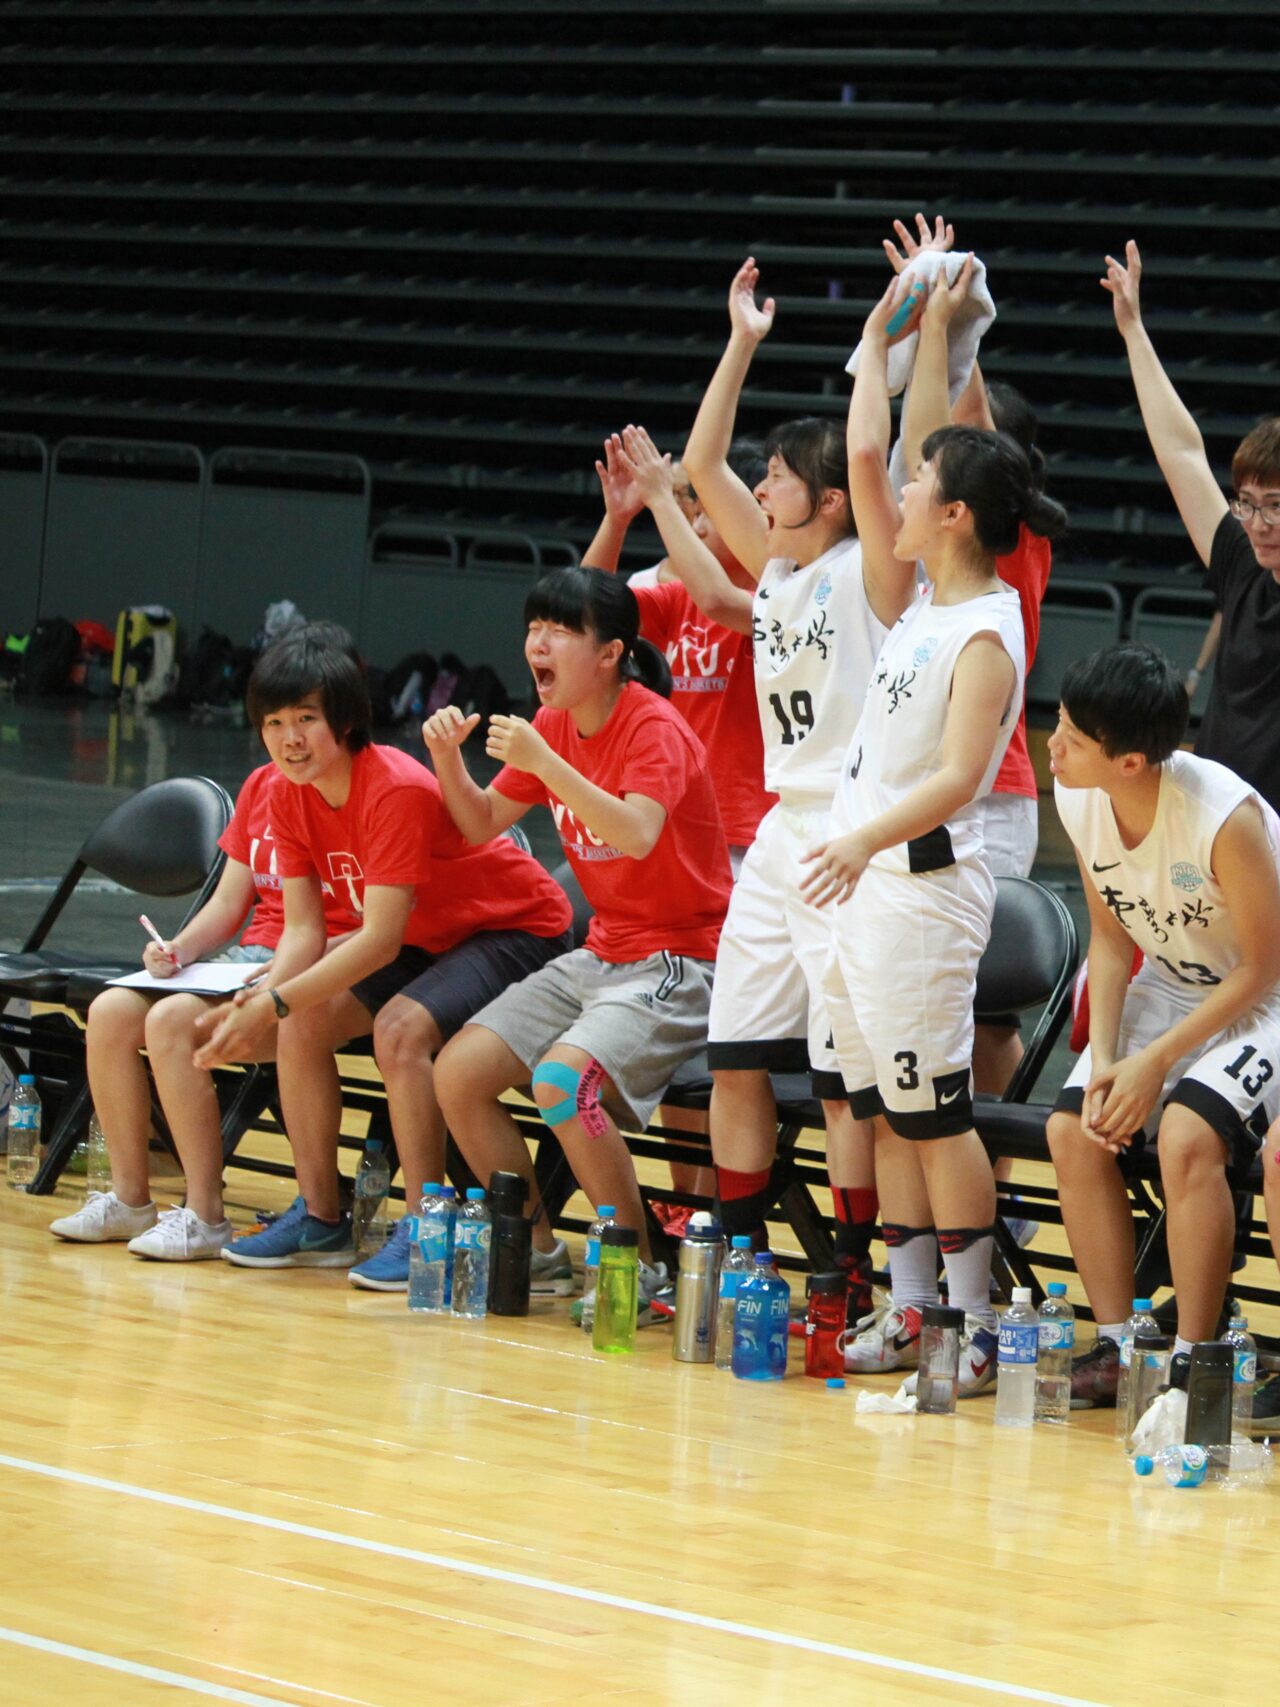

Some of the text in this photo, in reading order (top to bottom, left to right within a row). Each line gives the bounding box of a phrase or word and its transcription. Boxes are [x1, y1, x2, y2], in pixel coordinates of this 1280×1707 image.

[769, 690, 815, 745] 19
[894, 1051, 919, 1090] 3
[1223, 1045, 1273, 1097] 13
[737, 1299, 762, 1314] FIN
[770, 1299, 789, 1316] FIN
